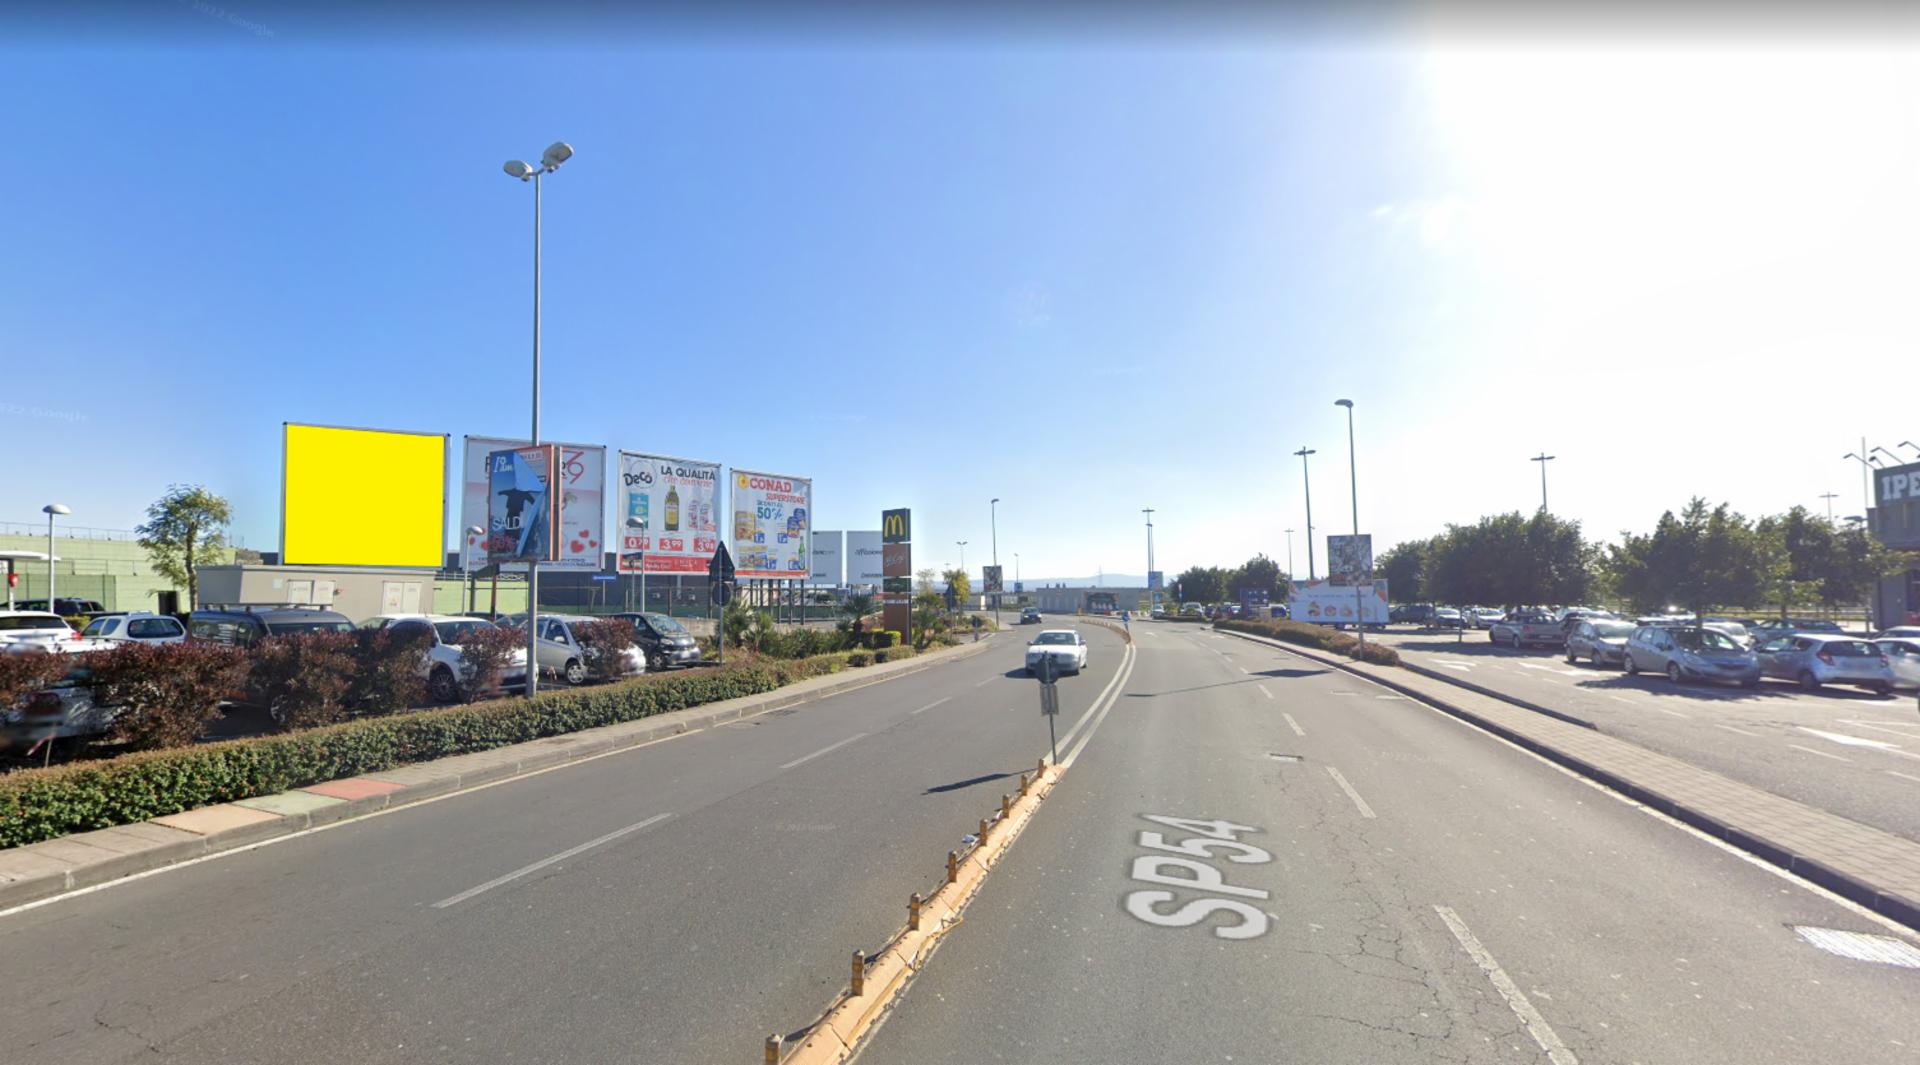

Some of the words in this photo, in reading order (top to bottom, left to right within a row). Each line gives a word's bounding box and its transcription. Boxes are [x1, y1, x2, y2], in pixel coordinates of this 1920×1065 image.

[660, 465, 673, 476] LA
[675, 467, 716, 480] QUALITÀ
[750, 477, 792, 493] CONAD
[1882, 471, 1920, 501] IPE
[766, 493, 806, 504] SUPERSTORE
[1125, 813, 1274, 940] SP54
